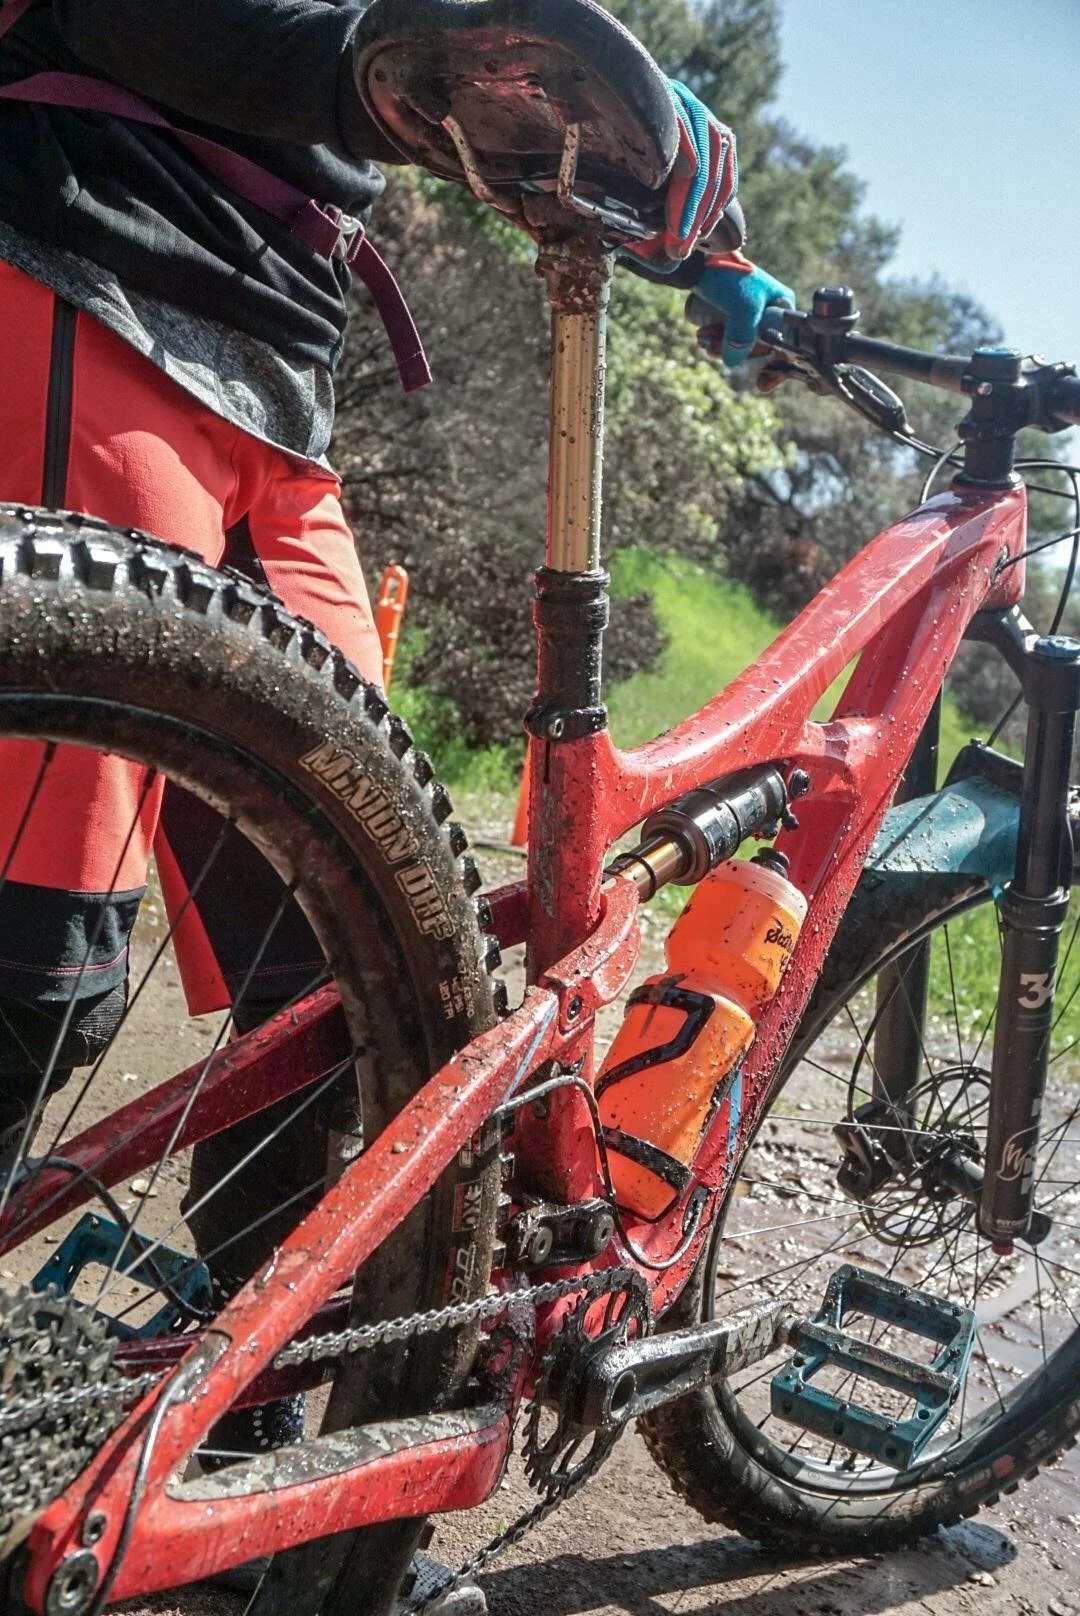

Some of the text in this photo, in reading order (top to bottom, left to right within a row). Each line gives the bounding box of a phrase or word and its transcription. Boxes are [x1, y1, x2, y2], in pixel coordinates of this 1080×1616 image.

[300, 741, 456, 940] MINION DHF
[439, 980, 455, 1019] 120 TPI
